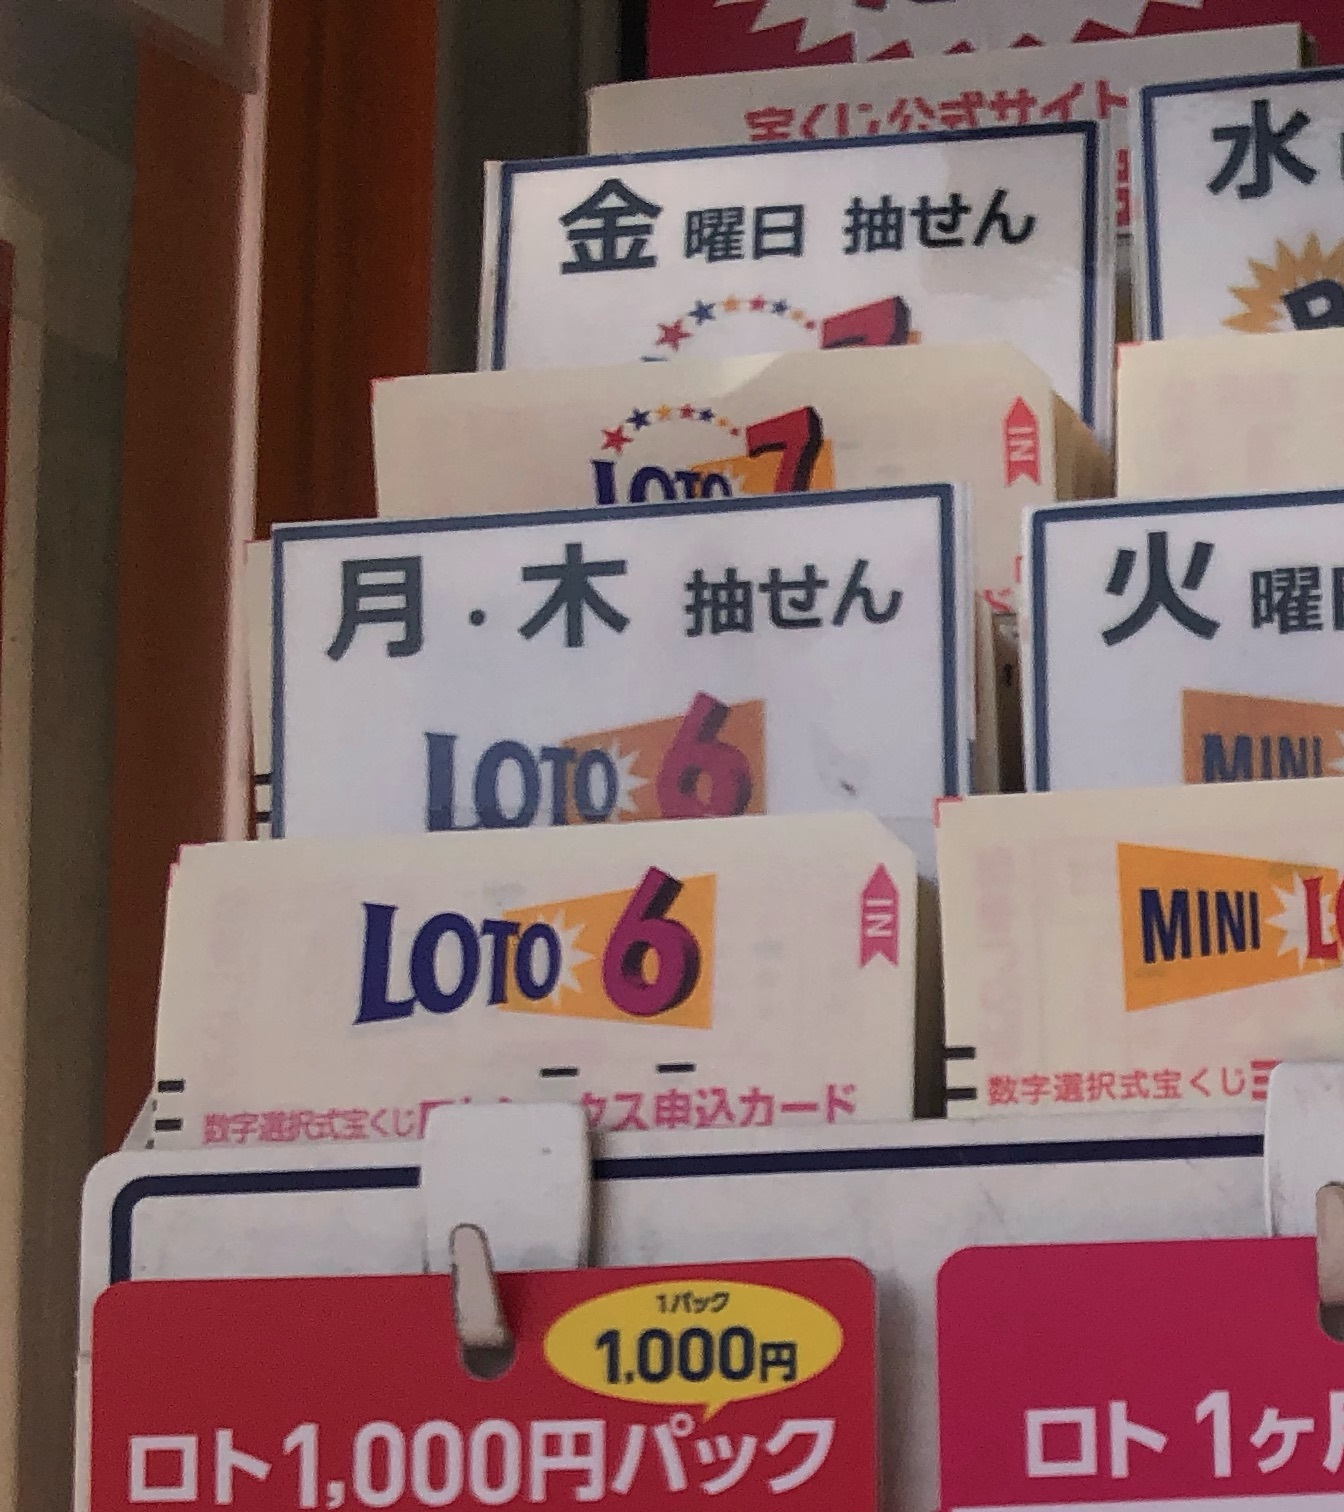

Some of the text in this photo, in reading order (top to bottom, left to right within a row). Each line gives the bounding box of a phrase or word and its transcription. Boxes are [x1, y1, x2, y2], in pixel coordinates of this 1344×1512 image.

[560, 177, 1035, 274] 金曜日 抽せん
[684, 559, 903, 638] 抽せん
[424, 731, 620, 833] LOTO
[352, 866, 701, 1025] LOTO 6
[1139, 888, 1262, 965] MINI
[988, 1067, 1246, 1106] 数字選択式宝くじ
[129, 1413, 836, 1509] ロト1,000円パック
[1025, 1402, 1167, 1479] ロト
